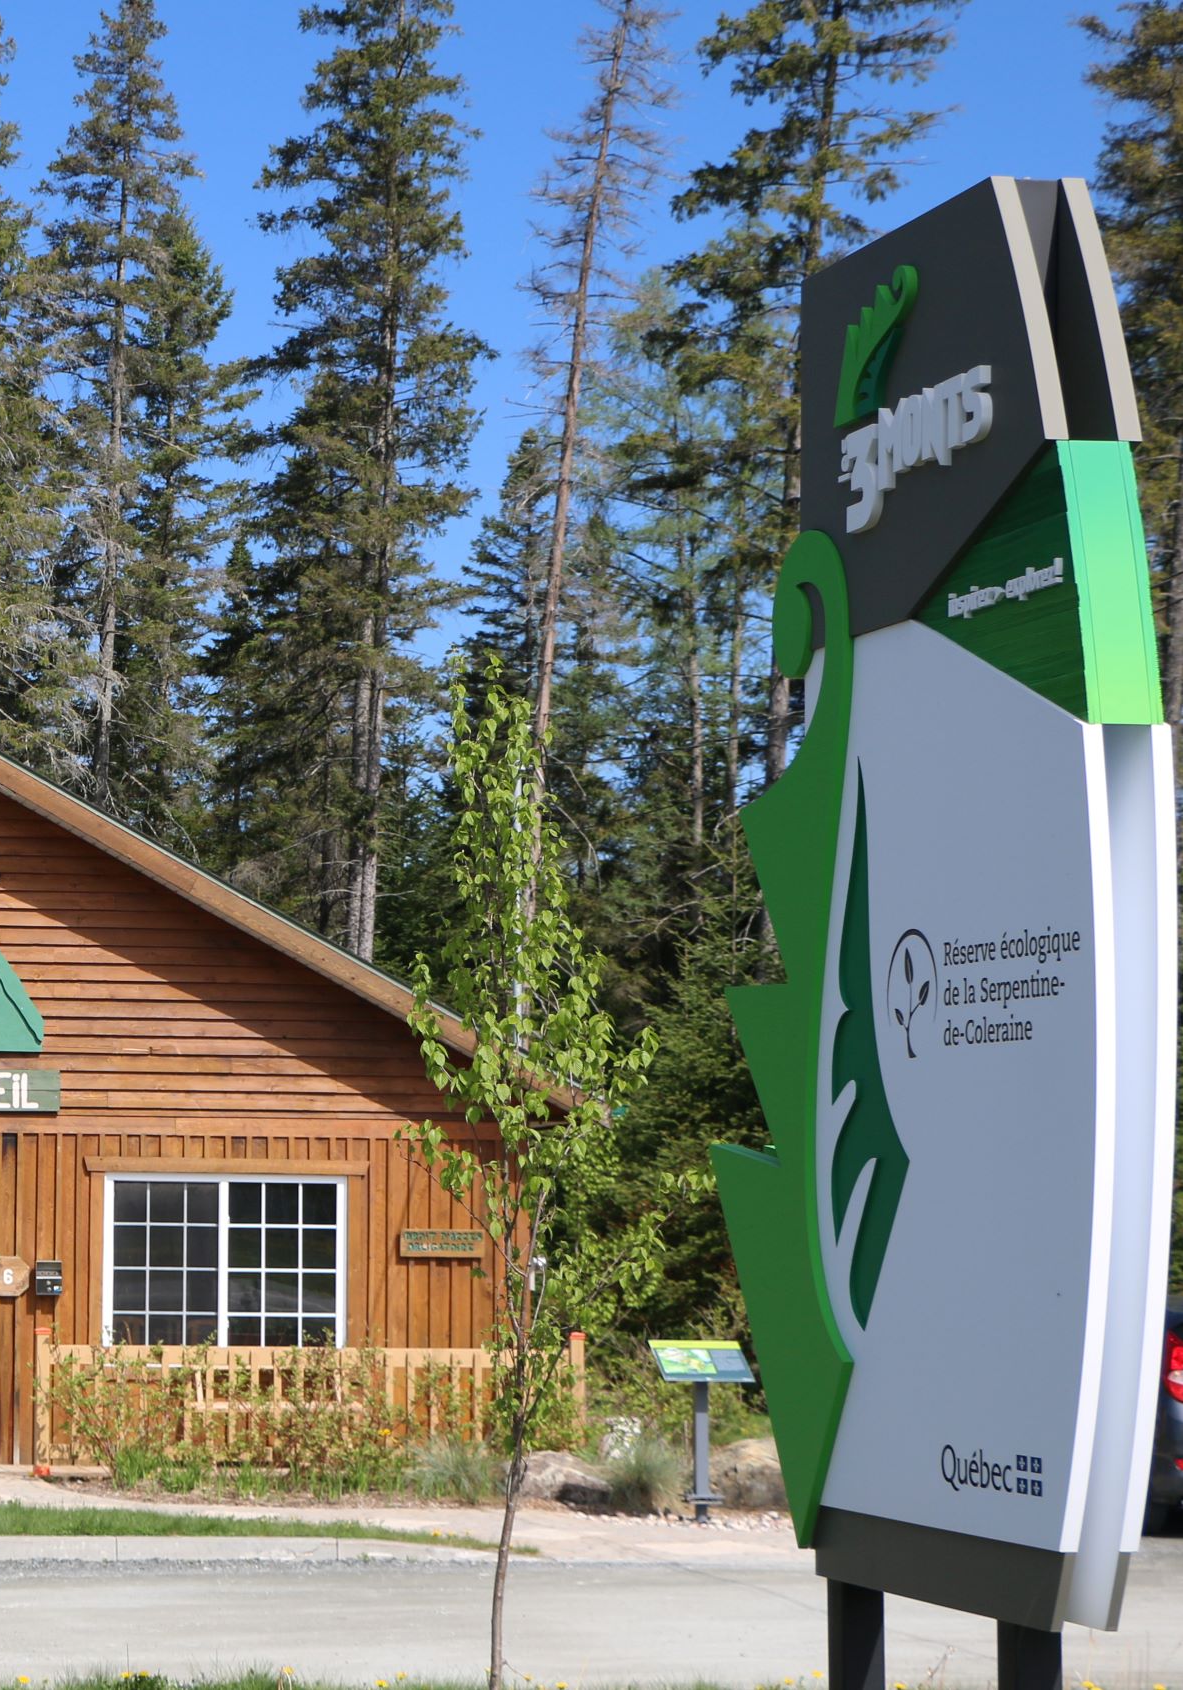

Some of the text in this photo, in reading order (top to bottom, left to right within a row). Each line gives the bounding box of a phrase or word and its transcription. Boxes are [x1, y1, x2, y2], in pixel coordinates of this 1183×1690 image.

[878, 364, 994, 492] MONTS
[943, 926, 1081, 967] Réserve écologique
[943, 969, 1066, 1009] de la Serpentine-
[943, 1014, 1034, 1046] de-Coleraine
[3, 1268, 14, 1285] 6
[941, 1444, 1013, 1493] Québec
